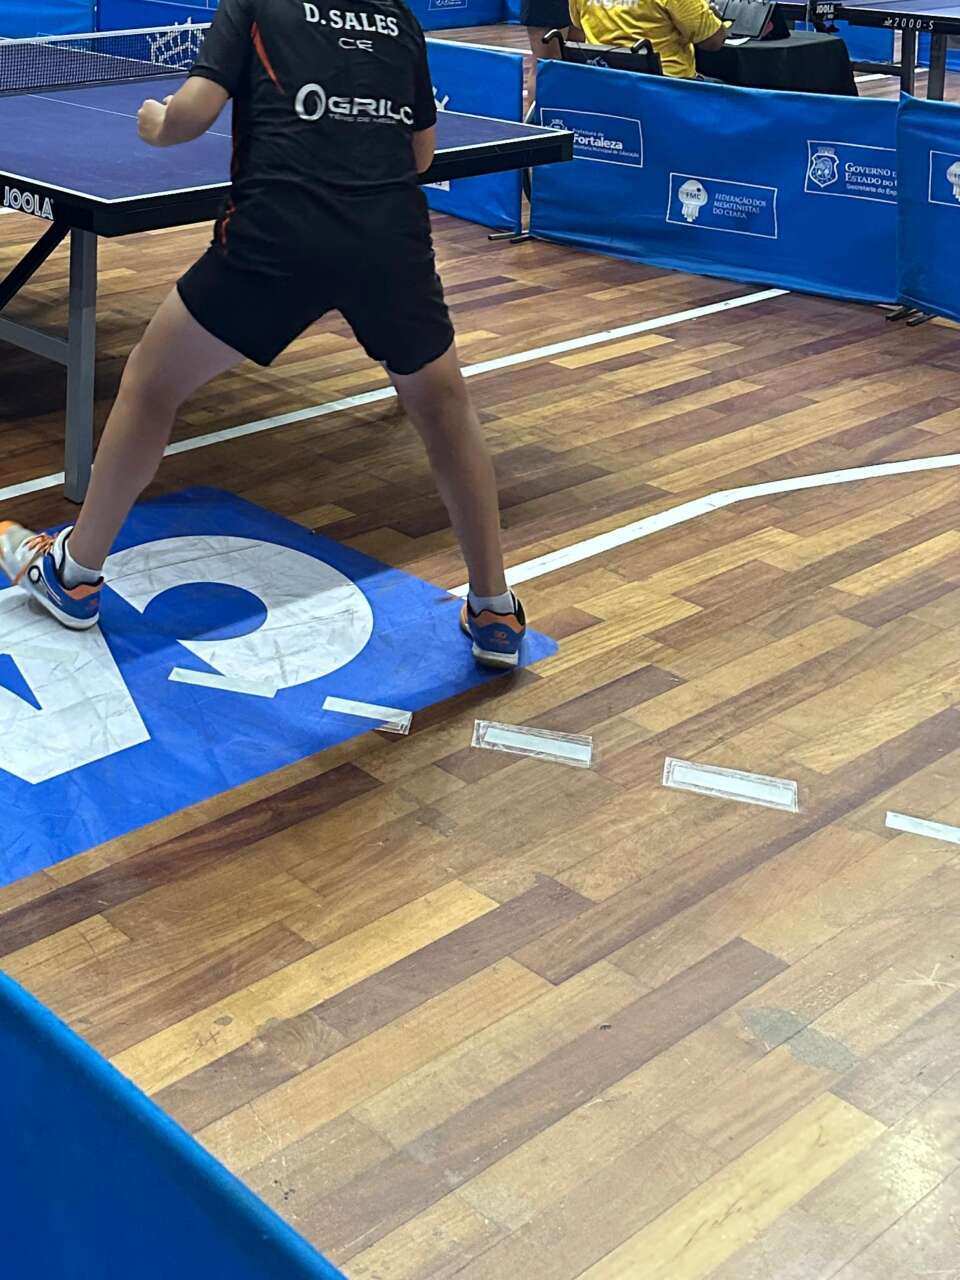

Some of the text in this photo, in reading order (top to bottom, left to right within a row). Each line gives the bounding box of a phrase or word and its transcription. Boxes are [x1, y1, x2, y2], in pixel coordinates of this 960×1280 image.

[303, 2, 401, 37] D. SALES
[338, 37, 374, 53] CE
[573, 133, 623, 150] Fortaleza
[845, 162, 891, 176] GOVERNO
[845, 172, 881, 185] ESTADO
[3, 185, 54, 221] JOOLA
